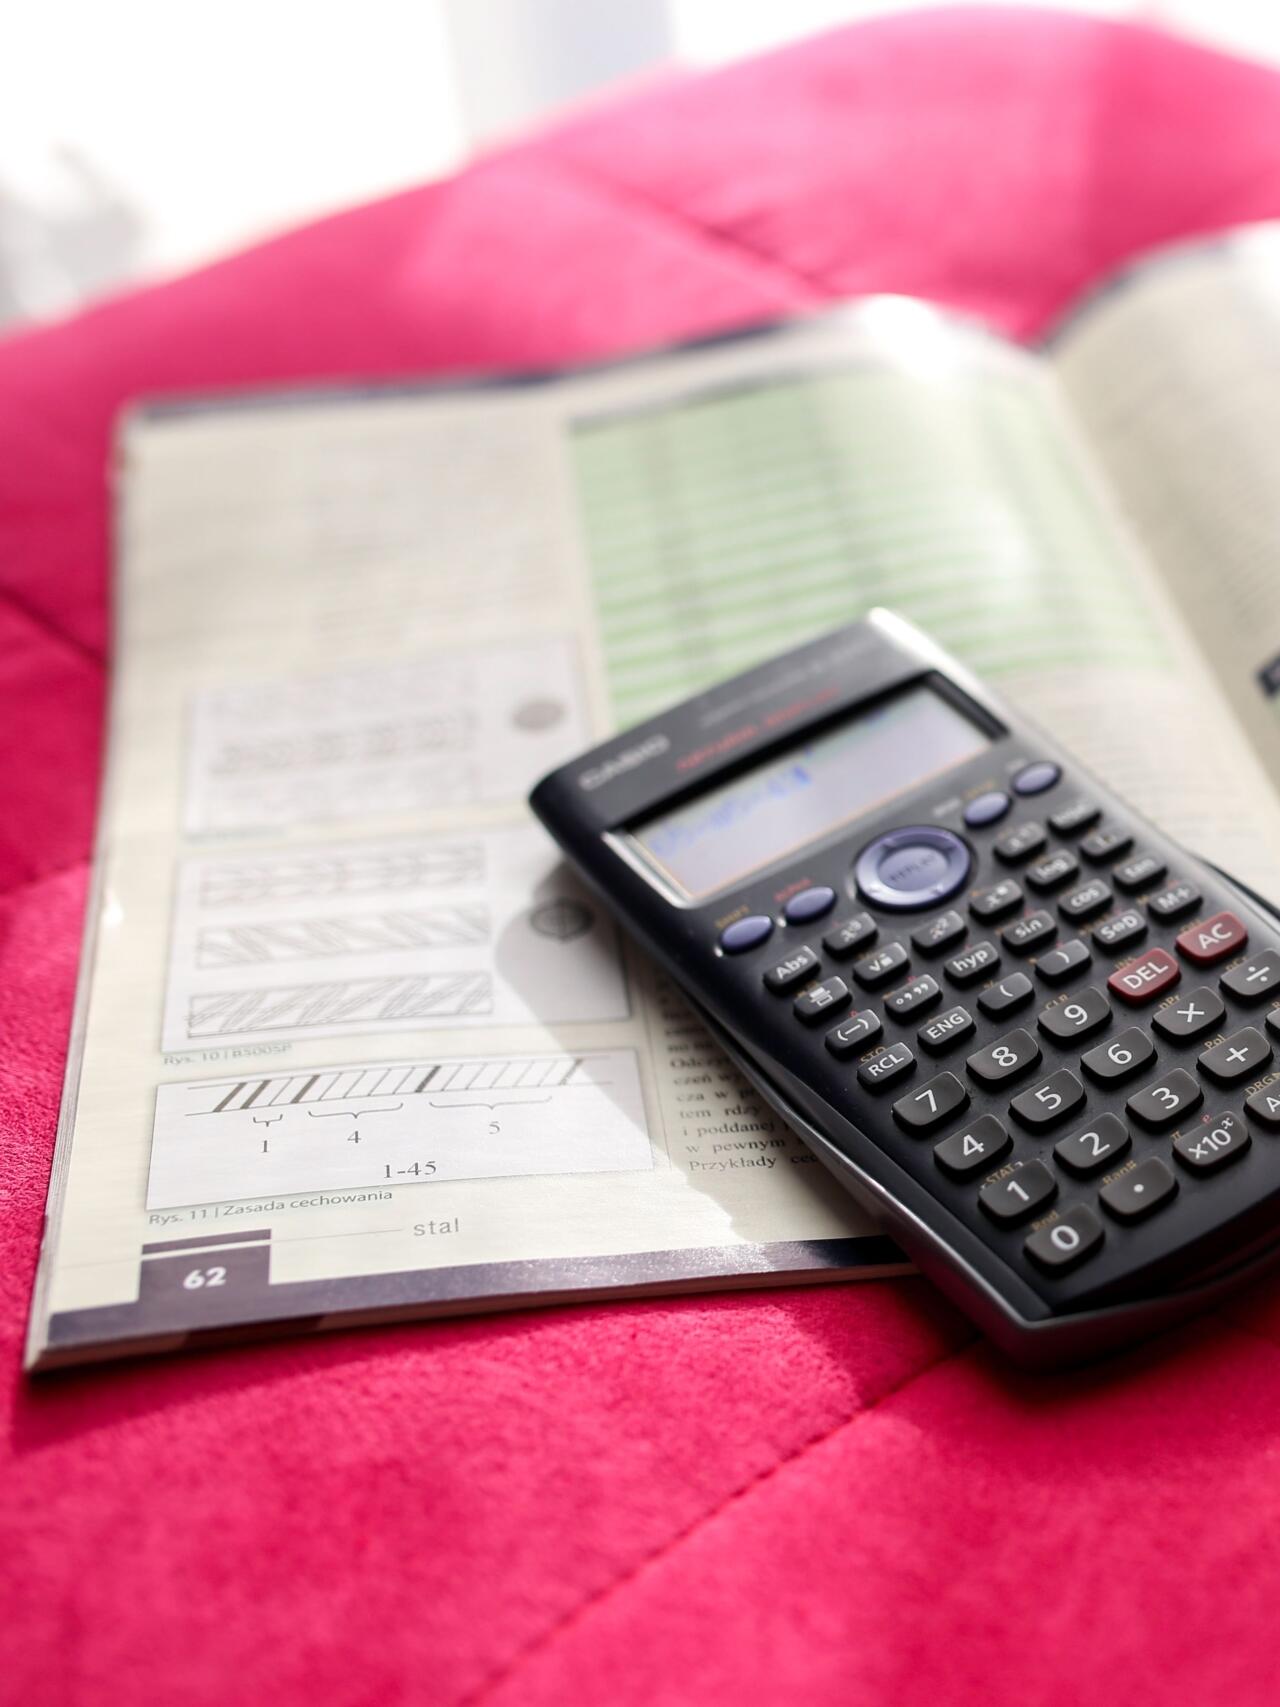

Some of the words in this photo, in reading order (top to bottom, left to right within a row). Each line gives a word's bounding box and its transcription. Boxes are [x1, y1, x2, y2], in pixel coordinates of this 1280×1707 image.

[1070, 888, 1099, 907] cos
[1157, 887, 1190, 909] M+
[1015, 919, 1043, 938] sin
[1198, 922, 1232, 950] AC
[775, 954, 808, 981] Abs
[953, 950, 988, 972] hyp
[1122, 961, 1169, 989] DEL
[1063, 1004, 1088, 1025] 9
[926, 1013, 965, 1039] ENG
[1107, 1042, 1132, 1065] 6
[1204, 1034, 1226, 1051] Pol
[867, 1053, 905, 1077] RCL
[991, 1046, 1018, 1067] 8
[915, 1089, 938, 1112] 7
[1034, 1086, 1062, 1110] 5
[1152, 1086, 1180, 1109] 3
[680, 1109, 711, 1119] tem
[347, 1130, 362, 1144] 4
[489, 1120, 501, 1135] 5
[698, 1121, 776, 1138] poddanej
[261, 1139, 270, 1154] 1
[687, 1144, 700, 1153] w
[713, 1139, 786, 1155] pewnym
[962, 1134, 985, 1156] 4
[1079, 1132, 1111, 1156] 2
[383, 1160, 437, 1179] 1-45
[689, 1156, 777, 1172] Przykłady
[1102, 1160, 1137, 1185] Ran#
[1007, 1181, 1029, 1201] 1
[149, 1214, 183, 1226] Rys.
[190, 1209, 207, 1220] 11
[223, 1200, 285, 1216] Zasada
[290, 1190, 393, 1209] cechowania
[413, 1217, 460, 1237] stal
[1050, 1225, 1080, 1250] 0
[183, 1266, 227, 1290] 62
